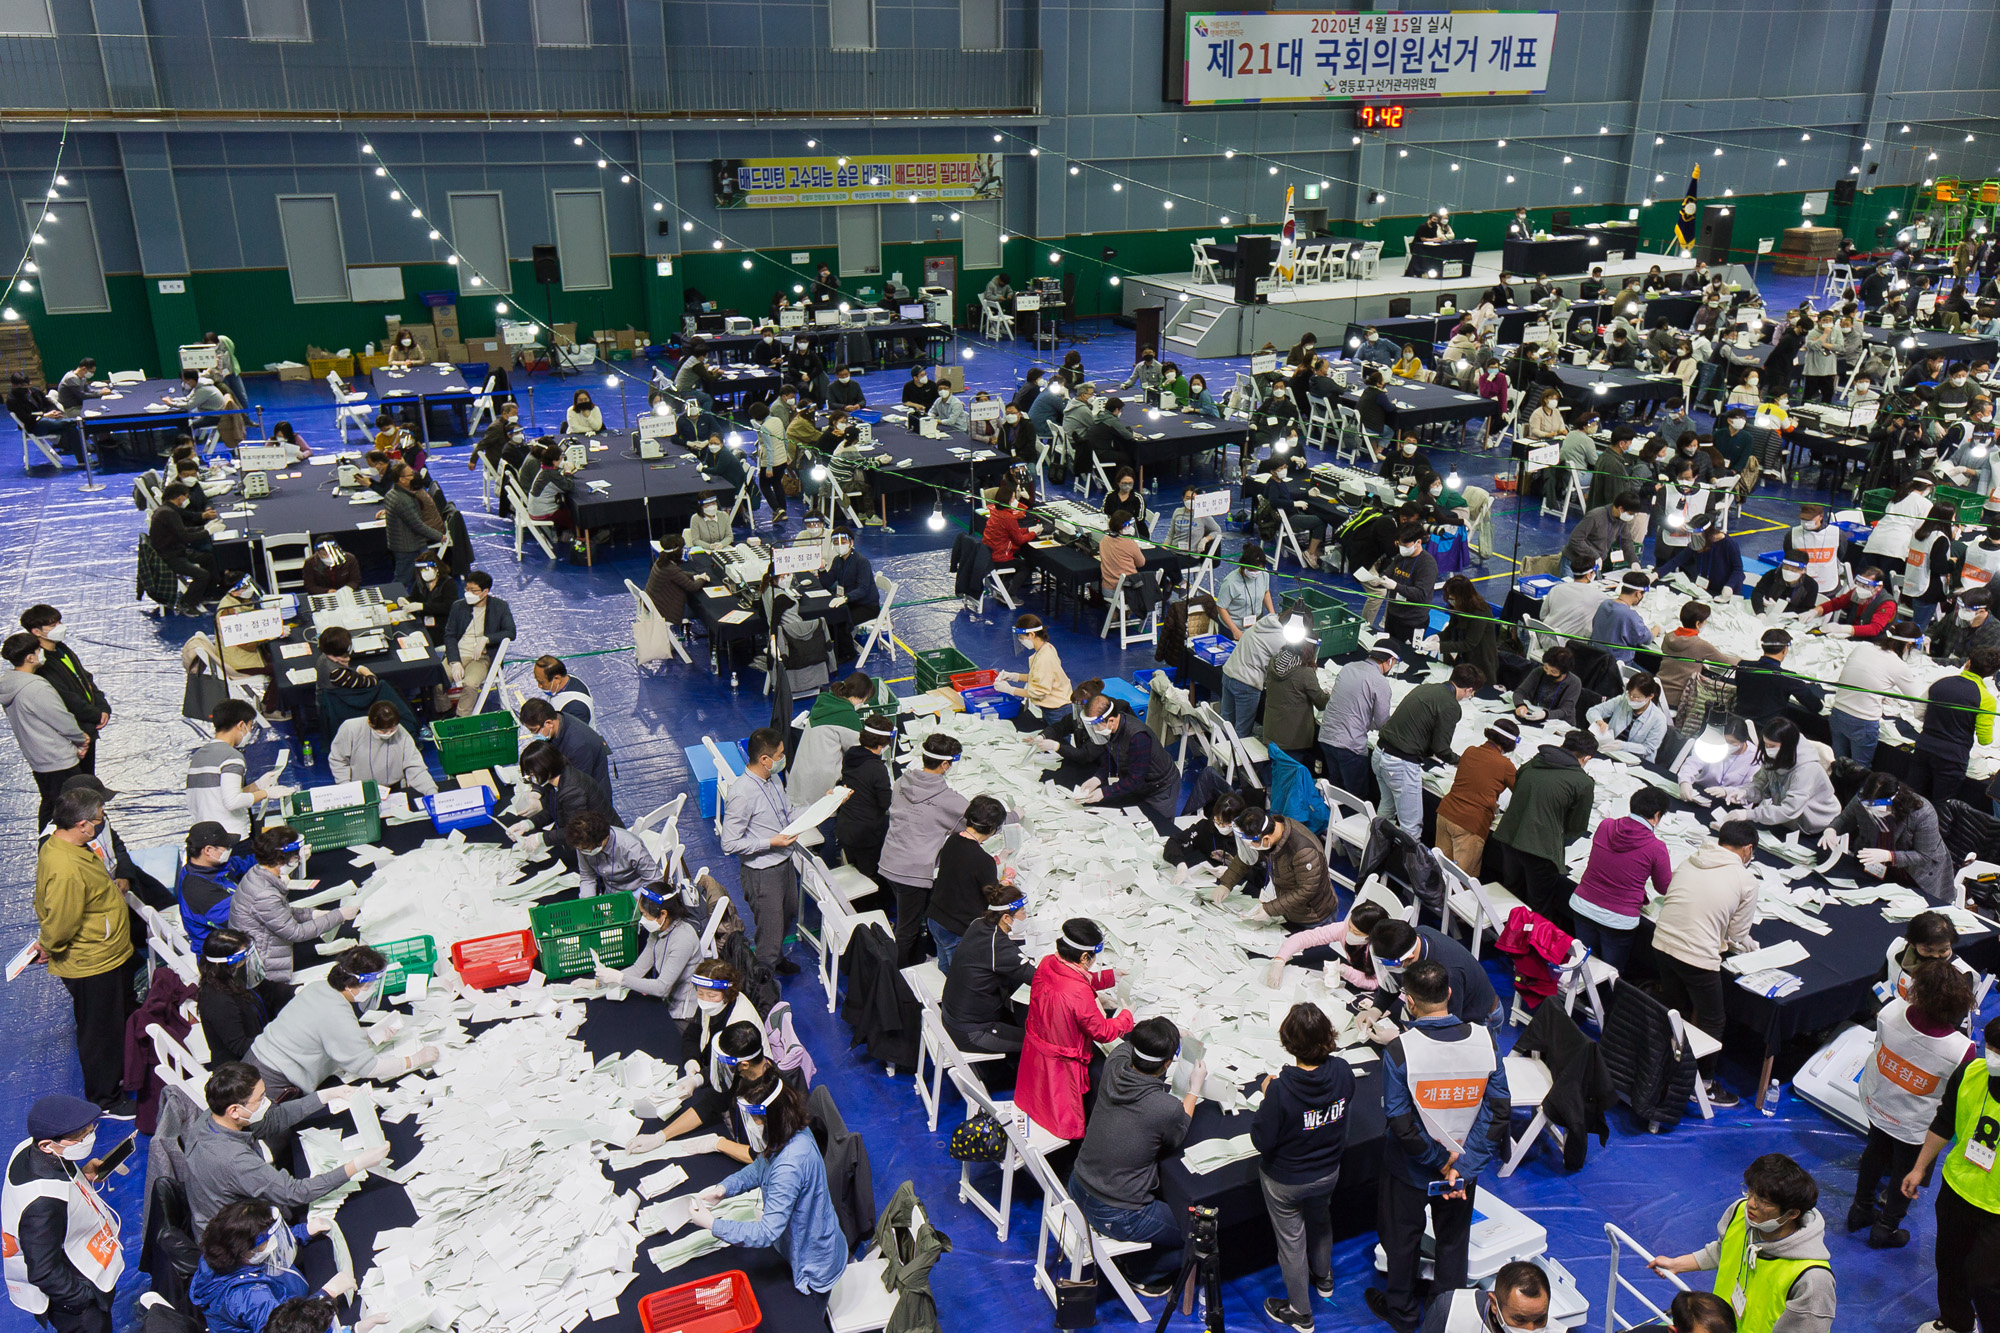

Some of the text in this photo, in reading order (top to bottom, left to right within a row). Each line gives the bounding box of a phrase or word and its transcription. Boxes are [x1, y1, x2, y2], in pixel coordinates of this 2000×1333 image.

[1311, 16, 1453, 34] 2020년 4월 15일 실시
[1207, 35, 1538, 78] 제21대 국회의원선거 개표
[1339, 77, 1437, 93] 영등포구선거관리위원회
[738, 167, 786, 190] 배드민턴
[788, 165, 833, 188] 고수되는
[837, 165, 858, 187] 숨은
[894, 163, 937, 185] 배드민턴
[940, 162, 981, 184] 필라테스
[1879, 1051, 1929, 1091] 개표참관
[1423, 1085, 1480, 1101] 개표참관
